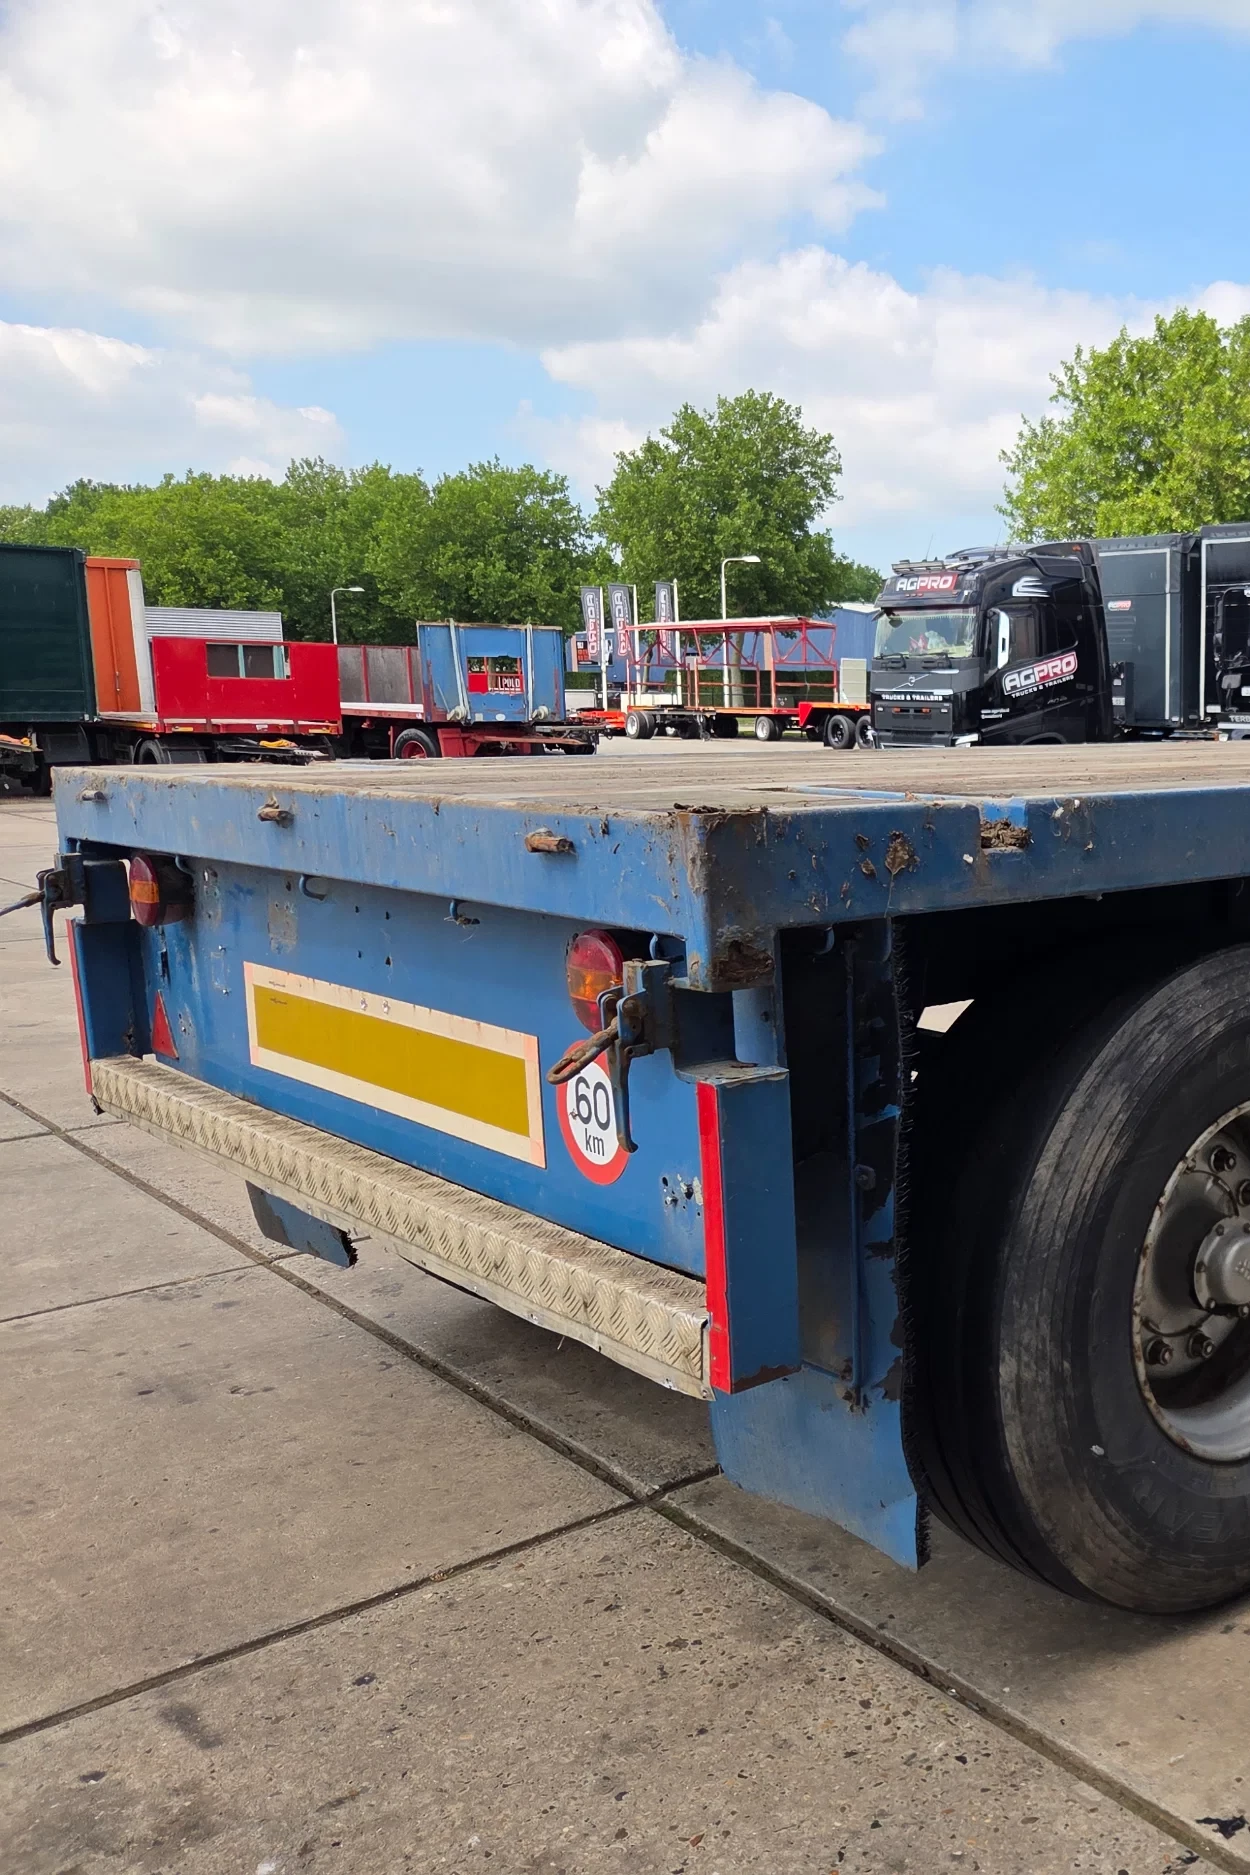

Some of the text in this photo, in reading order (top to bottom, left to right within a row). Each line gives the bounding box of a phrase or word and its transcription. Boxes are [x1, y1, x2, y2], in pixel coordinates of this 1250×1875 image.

[896, 576, 953, 591] AGPRO
[1004, 655, 1076, 691] AGPRO
[881, 693, 905, 701] TRUCKS
[912, 694, 943, 702] TRAILERS
[1011, 687, 1038, 699] TRUCKS
[1045, 674, 1074, 688] TRAILERS
[575, 1076, 610, 1131] 60
[585, 1128, 604, 1156] km
